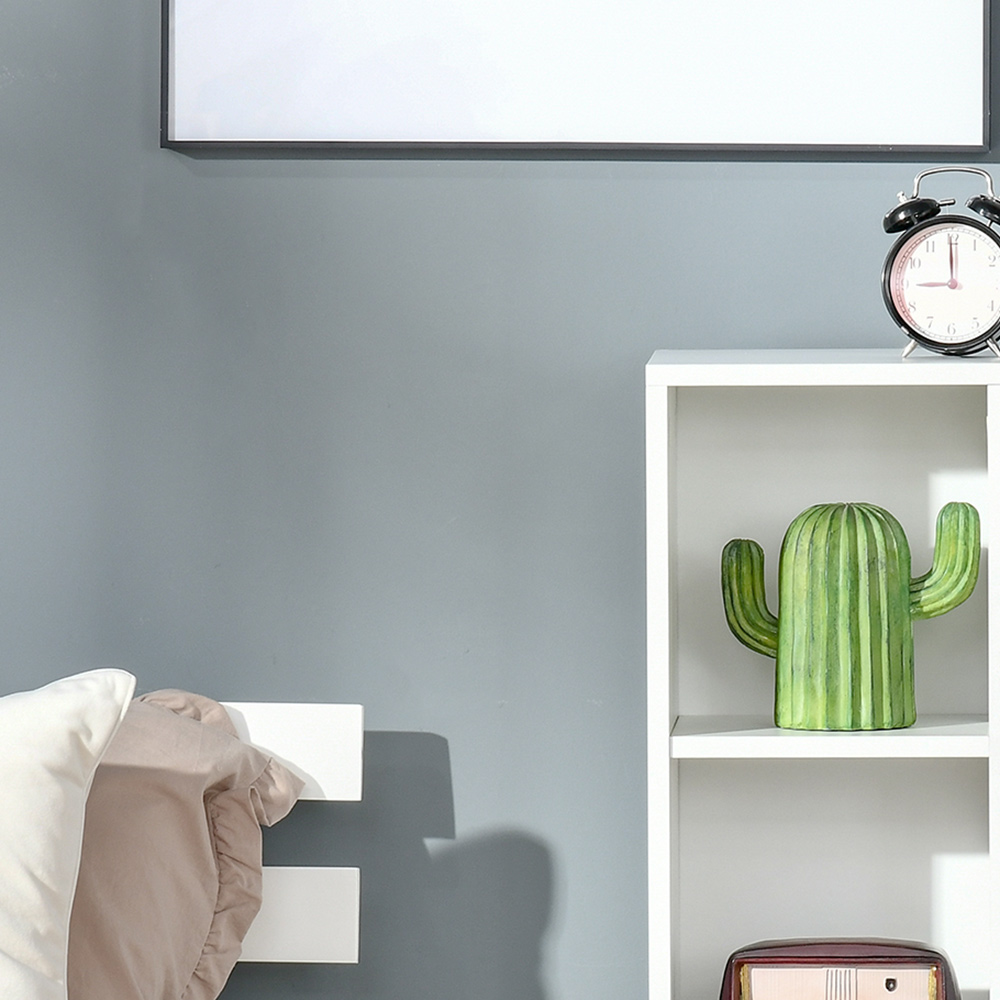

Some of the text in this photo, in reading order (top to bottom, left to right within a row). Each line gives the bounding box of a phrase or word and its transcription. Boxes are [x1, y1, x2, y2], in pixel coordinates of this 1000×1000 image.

[909, 256, 922, 269] 10
[926, 316, 934, 329] 7
[947, 323, 956, 335] 6
